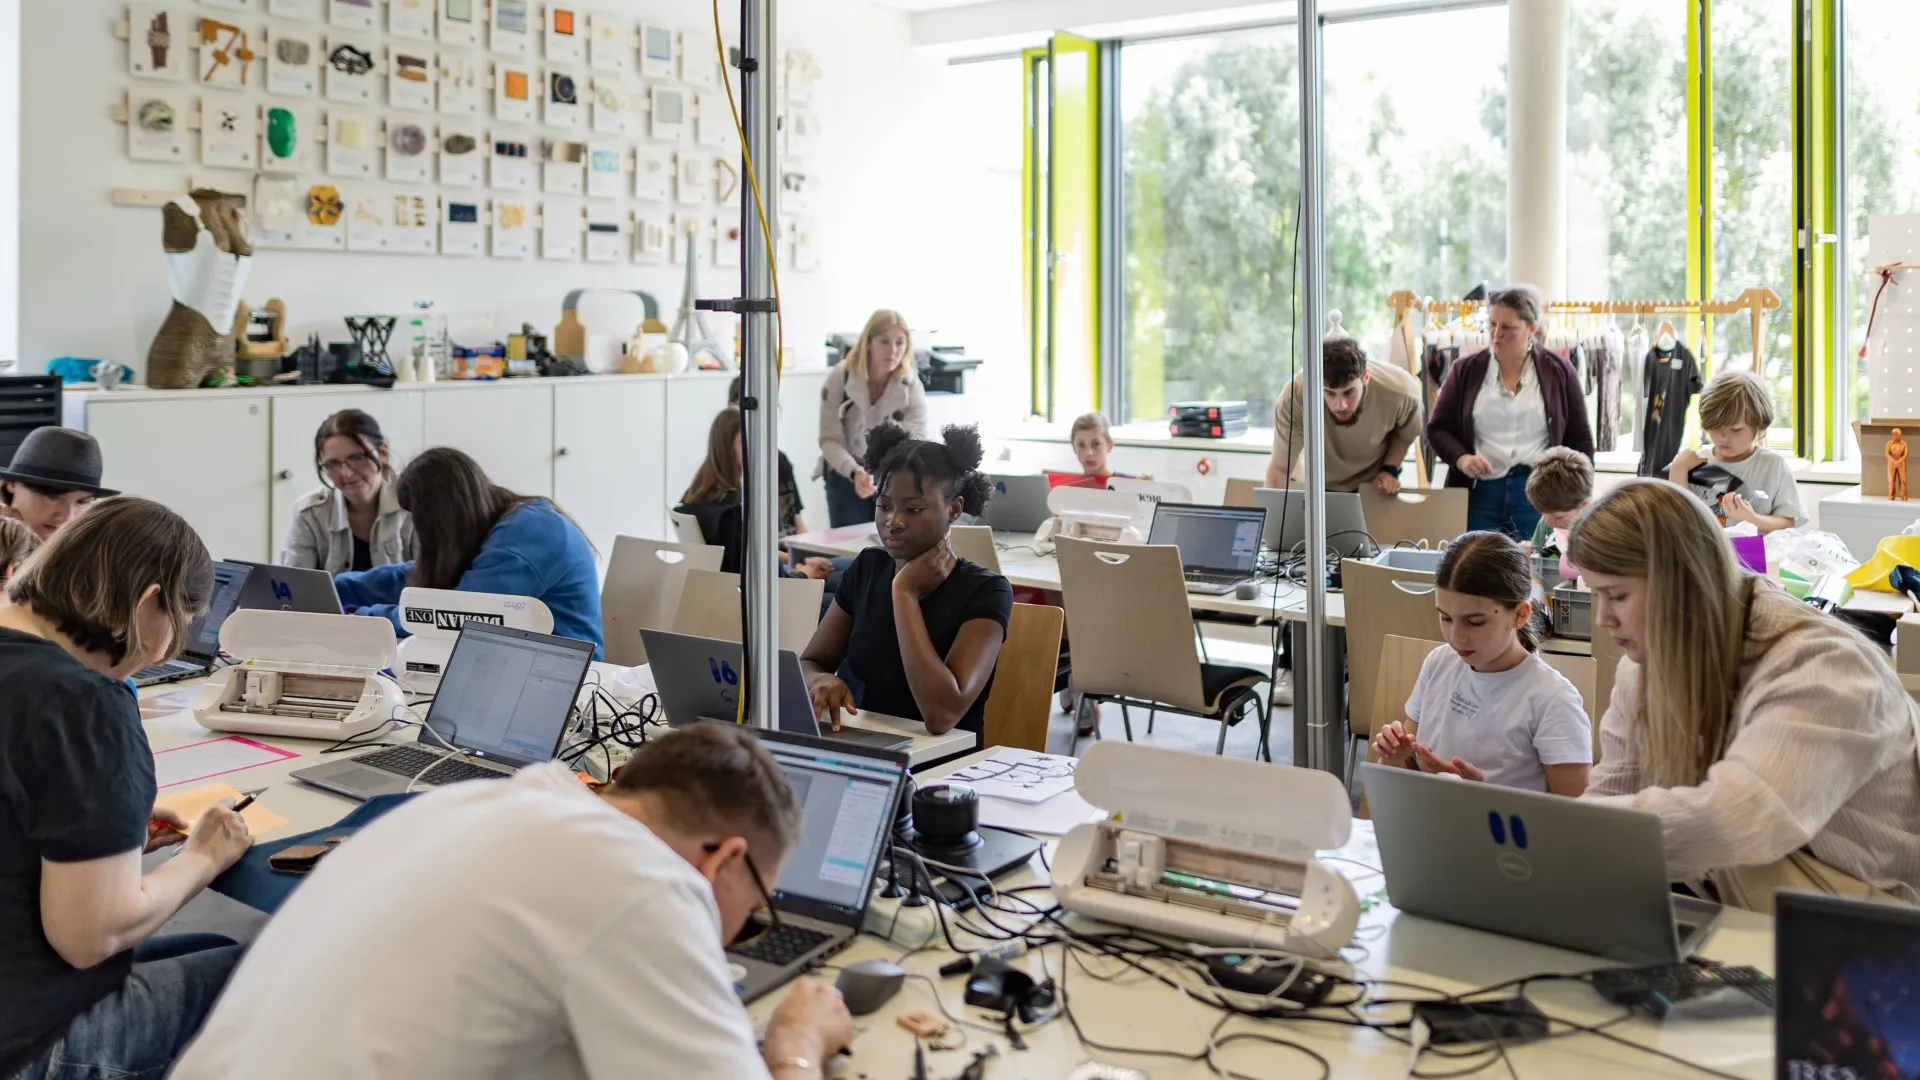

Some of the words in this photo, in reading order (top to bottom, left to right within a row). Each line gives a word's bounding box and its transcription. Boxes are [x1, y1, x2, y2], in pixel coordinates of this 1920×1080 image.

[1136, 492, 1162, 503] DIGM
[407, 610, 434, 623] ONE
[708, 656, 738, 685] 16
